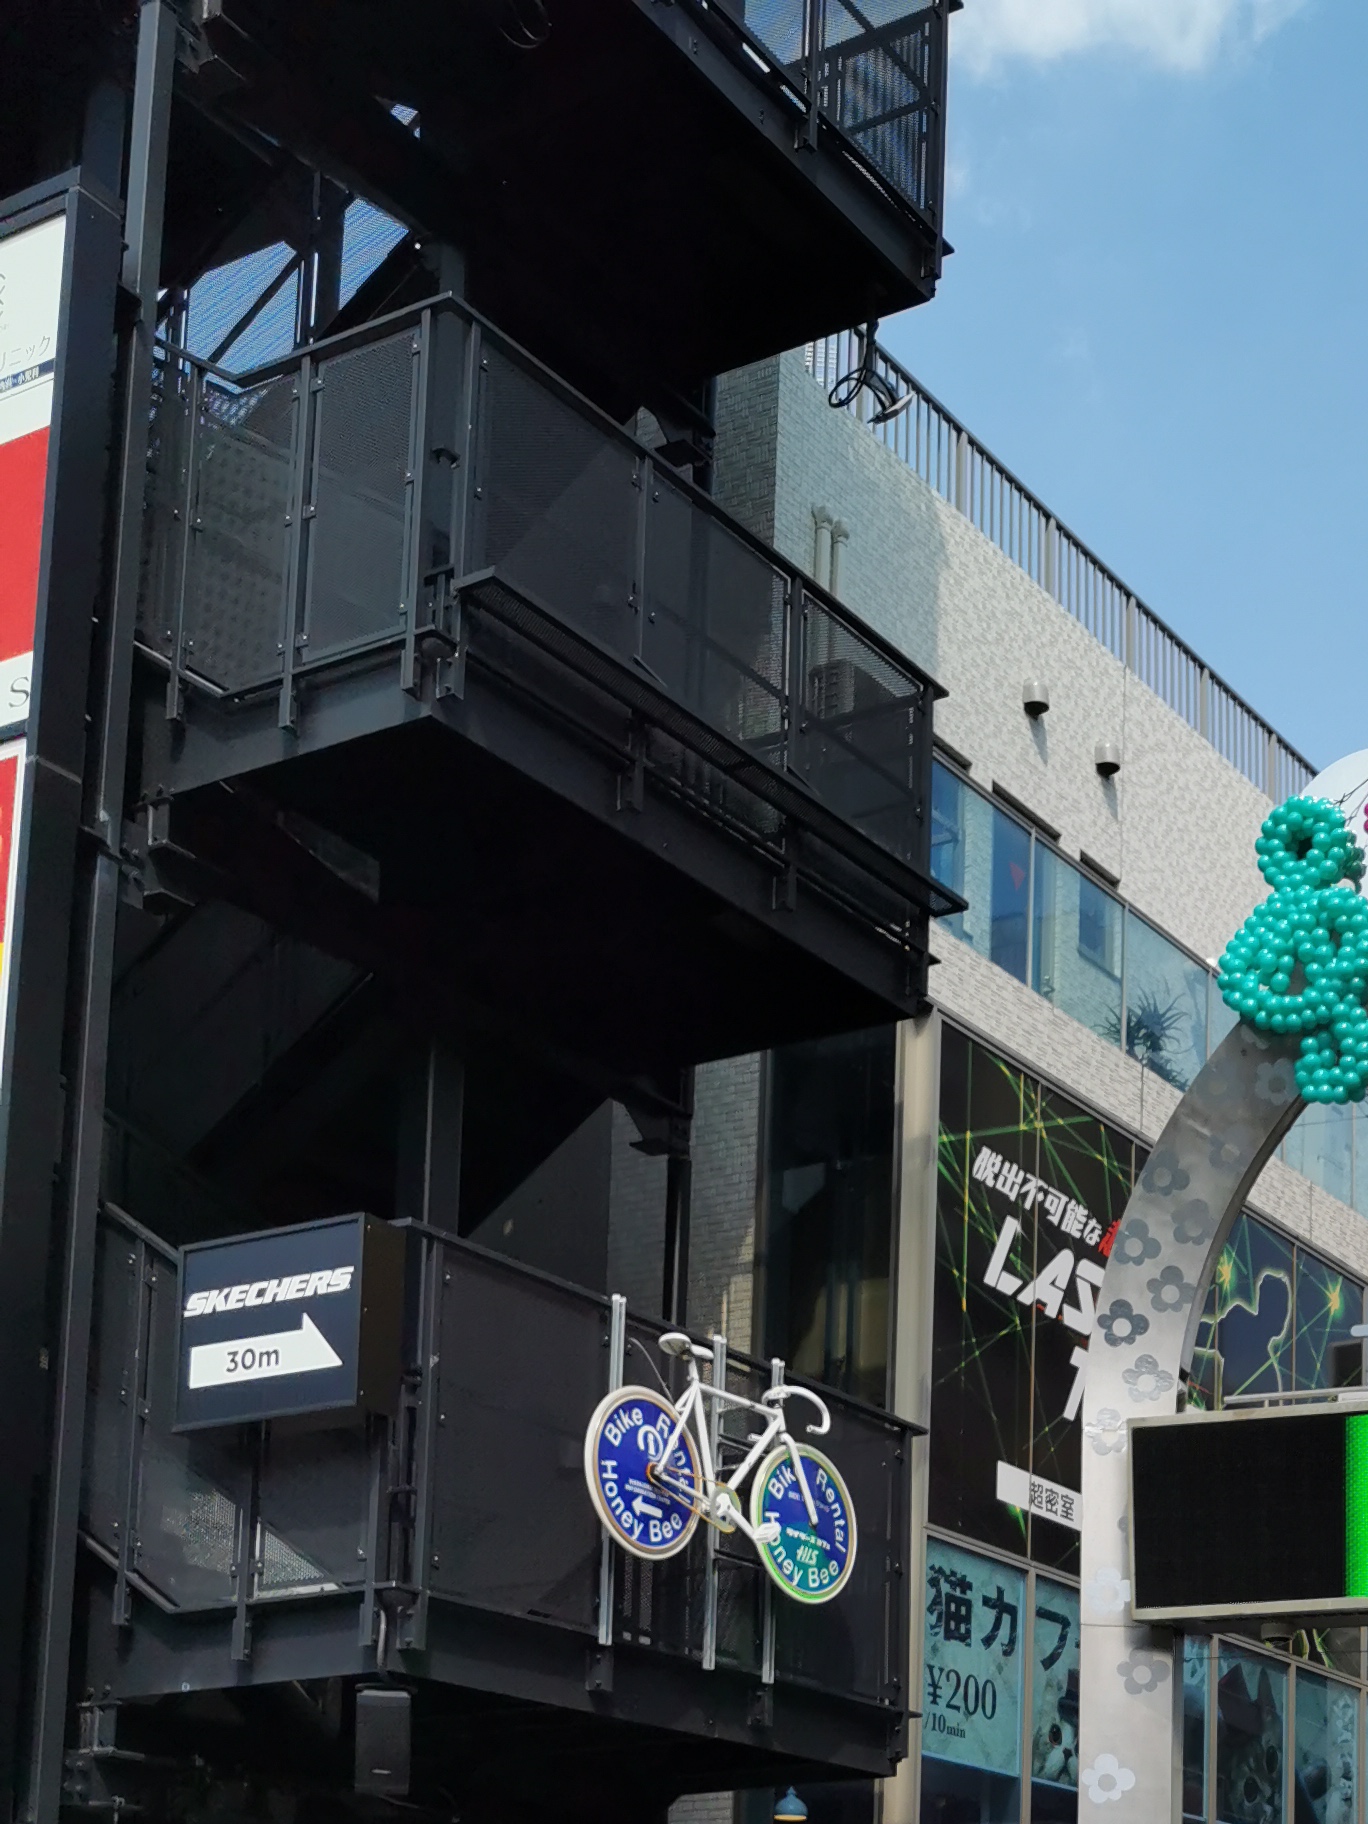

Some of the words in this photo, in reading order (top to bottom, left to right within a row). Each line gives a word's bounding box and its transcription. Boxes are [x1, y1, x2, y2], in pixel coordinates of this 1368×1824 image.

[184, 1265, 354, 1318] SKECHERS
[227, 1349, 280, 1373] 30m
[604, 1407, 643, 1447] Bike
[601, 1460, 644, 1541] Honey
[650, 1513, 683, 1542] Bee
[768, 1466, 798, 1500] Bik
[816, 1468, 847, 1553] Rental
[808, 1560, 839, 1588] Bee
[926, 1564, 1080, 1671] 猫カフ
[926, 1663, 997, 1720] ¥200
